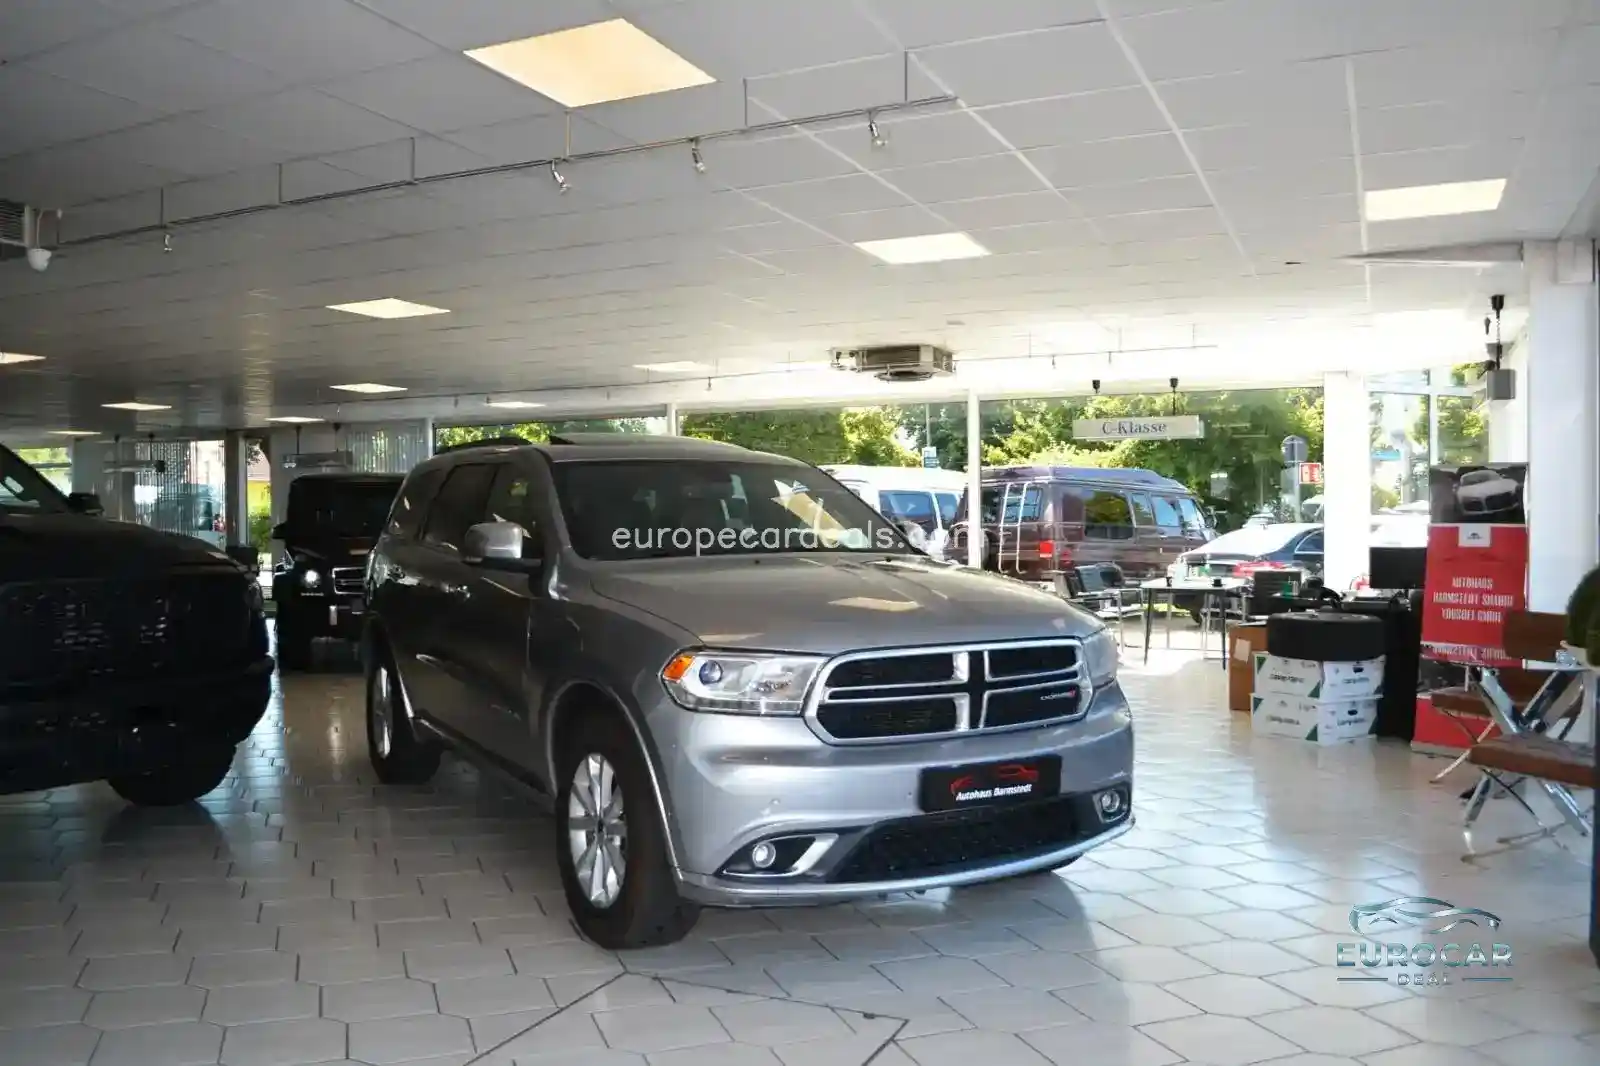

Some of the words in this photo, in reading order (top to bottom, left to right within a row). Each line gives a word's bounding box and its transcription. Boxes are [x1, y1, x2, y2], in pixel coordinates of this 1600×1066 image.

[1102, 420, 1167, 436] C-Klasse
[955, 788, 993, 801] Autohaus
[993, 783, 1033, 797] Barmstedt
